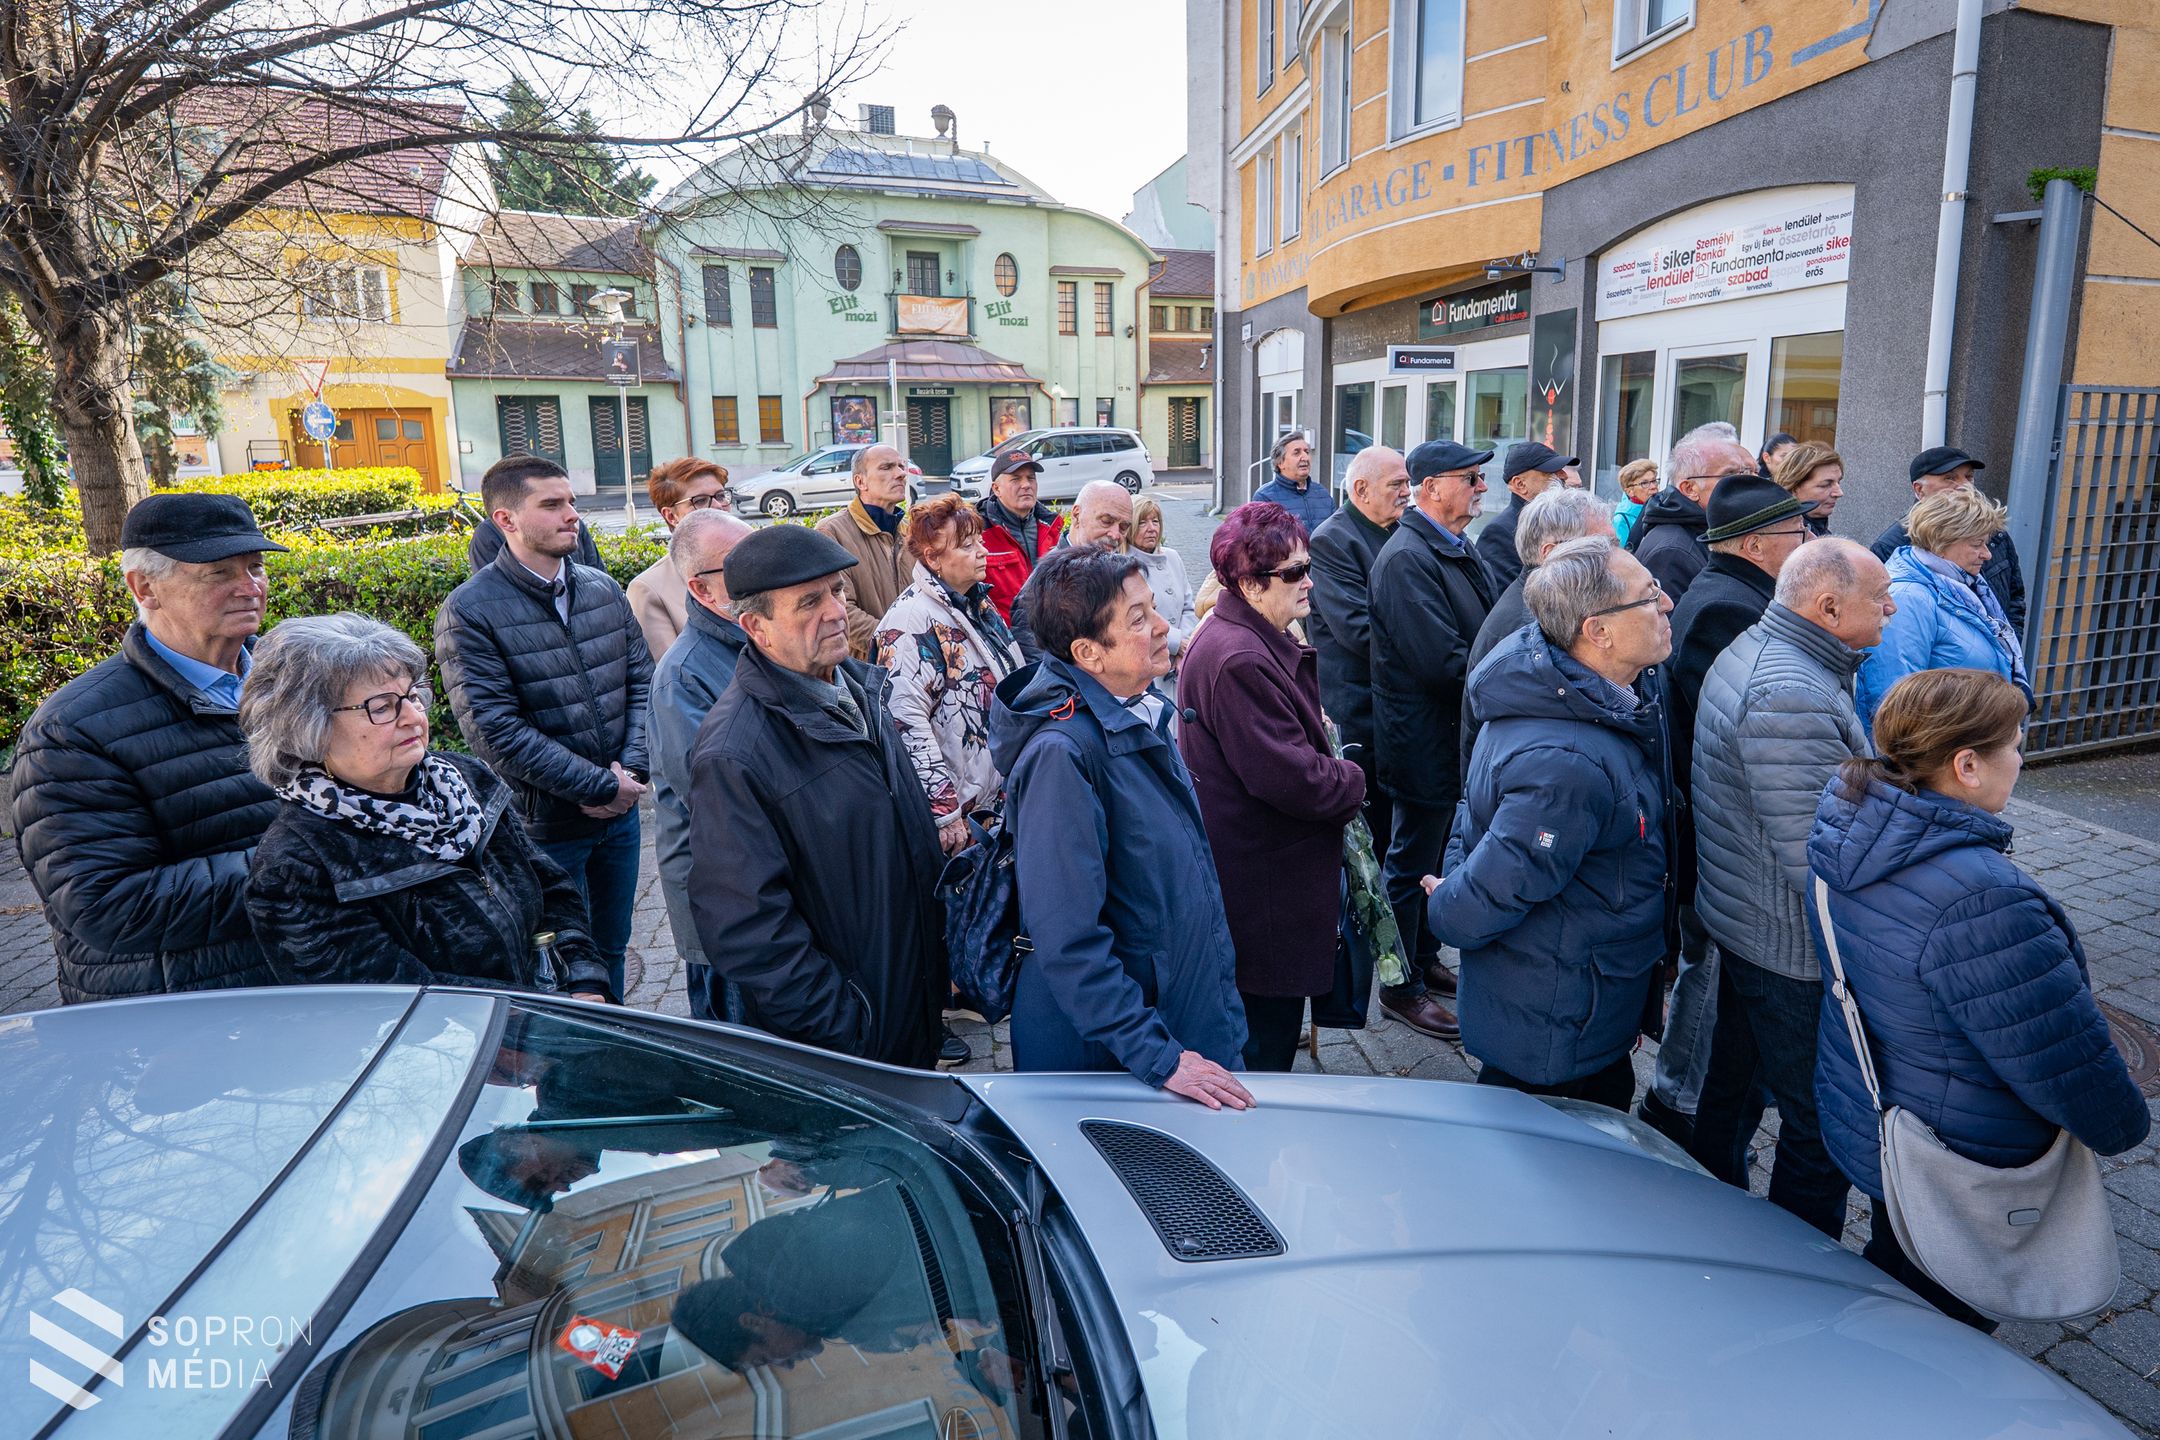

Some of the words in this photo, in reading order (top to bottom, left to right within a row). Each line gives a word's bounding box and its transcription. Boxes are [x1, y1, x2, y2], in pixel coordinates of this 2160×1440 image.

[1325, 160, 1432, 231] GARAGE
[1467, 92, 1630, 187] FITNESS
[1643, 24, 1774, 127] CLUB
[1785, 212, 1822, 231] lendület
[1696, 230, 1734, 250] Személyi
[1779, 221, 1836, 246] összetartó
[1696, 246, 1726, 262] Bankár
[1742, 244, 1753, 253] Egy
[1762, 238, 1773, 247] Élet
[1785, 244, 1823, 261] piacvezető
[1613, 261, 1636, 273] szabad
[1662, 250, 1696, 270] siker
[1711, 249, 1784, 275] Fundamenta
[1807, 253, 1846, 267] gondoskodó
[1647, 266, 1694, 290] lendület
[1728, 266, 1768, 286] szabad
[1806, 266, 1823, 278] erős
[1606, 286, 1632, 299] összetartó
[1667, 295, 1687, 305] csapat
[1689, 287, 1721, 301] innovatív
[827, 294, 859, 315] Elit
[984, 299, 1013, 320] Elit
[1449, 290, 1518, 323] Fundamenta
[845, 311, 878, 322] mozi
[1000, 316, 1029, 327] mozi
[1410, 357, 1451, 365] Fundamenta
